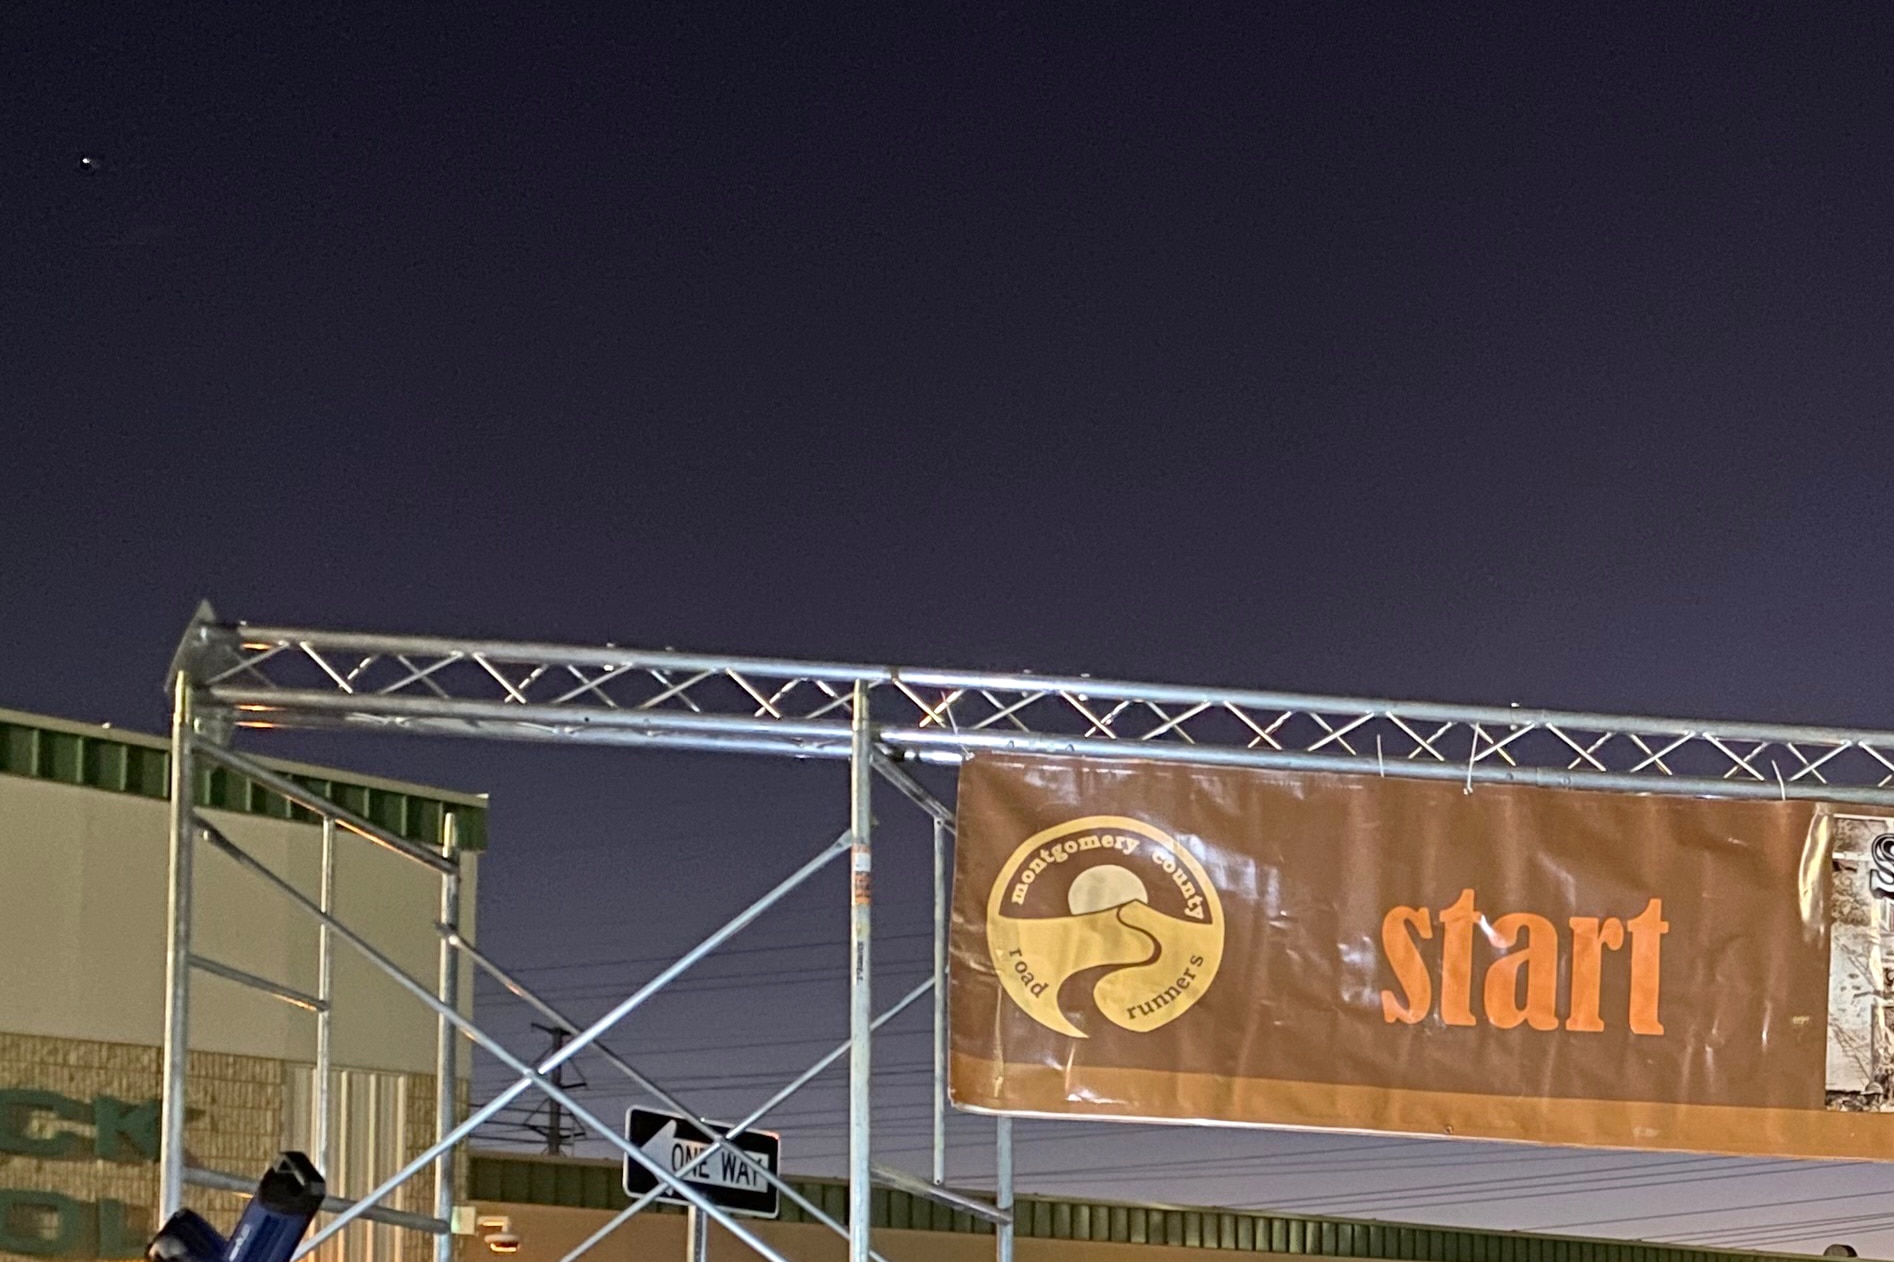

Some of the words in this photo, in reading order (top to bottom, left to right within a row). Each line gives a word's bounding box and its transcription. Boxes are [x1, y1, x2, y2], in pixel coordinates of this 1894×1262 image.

[1011, 834, 1140, 905] montgomery
[1151, 849, 1205, 920] county
[1009, 947, 1049, 999] road
[1126, 954, 1205, 1020] runners
[1380, 888, 1670, 1036] start
[671, 1143, 711, 1179] ONE
